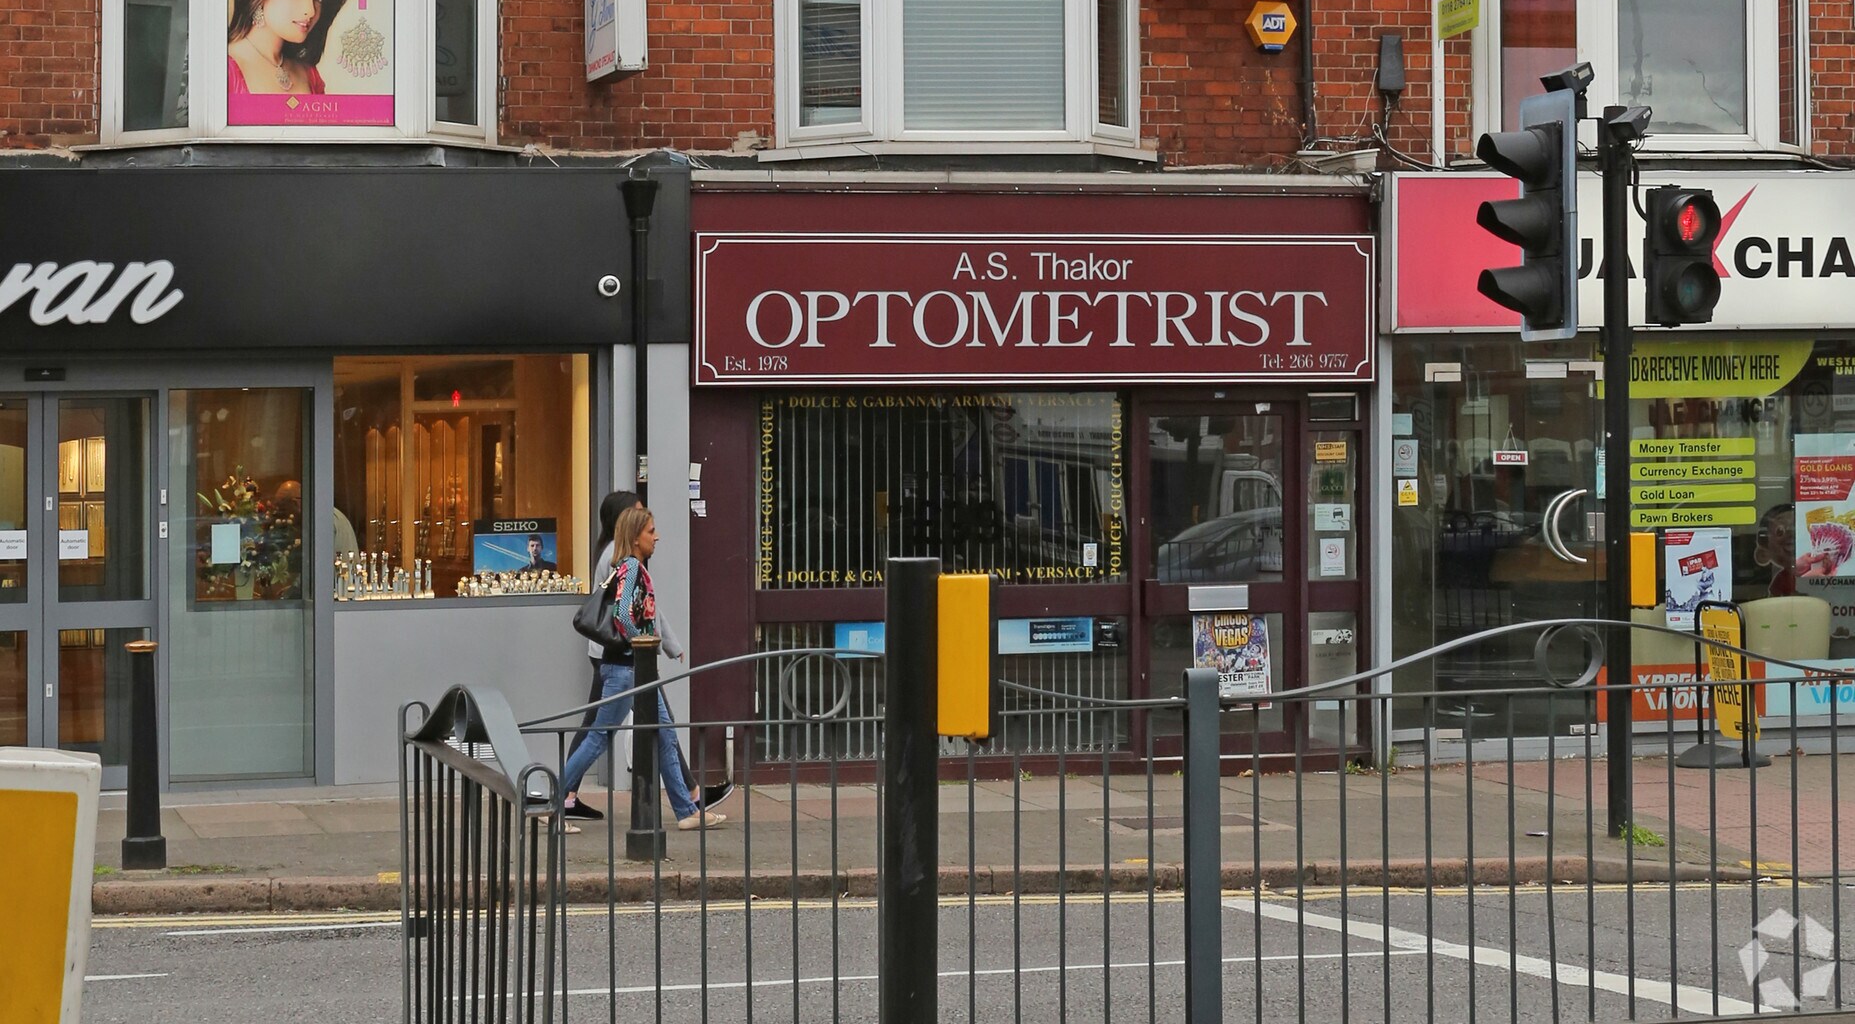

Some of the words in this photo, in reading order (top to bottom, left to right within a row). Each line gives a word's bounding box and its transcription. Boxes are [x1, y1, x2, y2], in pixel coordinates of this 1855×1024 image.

[1263, 17, 1286, 30] ADT
[302, 102, 338, 112] AGNI
[953, 252, 1016, 280] A.S.
[1030, 252, 1133, 280] Thakor
[746, 290, 1328, 348] OPTOMETRIST
[724, 356, 751, 371] Est.
[758, 356, 788, 371] 1978
[1259, 354, 1284, 368] Tel:
[1289, 354, 1314, 368] 266
[1319, 354, 1348, 368] 9757
[1702, 355, 1746, 381] MONEY
[1750, 354, 1780, 380] HERE
[789, 396, 841, 408] DOLCE
[846, 396, 857, 408] &
[863, 396, 937, 408] GABANNA
[952, 395, 1012, 407] ARMANI
[762, 400, 774, 455] VOGUE
[1640, 443, 1674, 454] Money
[1679, 442, 1721, 452] Transfer
[1640, 466, 1688, 478] Currency
[1692, 465, 1744, 476] Exchange
[1800, 464, 1822, 472] GOLD
[1824, 464, 1853, 472] LOANS
[762, 466, 774, 516] GUCCI
[1112, 462, 1122, 511] GUCCI
[1640, 490, 1665, 500] Gold
[1670, 490, 1695, 500] Loan
[1640, 513, 1668, 523] Pawn
[1672, 512, 1714, 522] Brokers
[493, 521, 538, 532] SEIKO
[762, 525, 773, 582] POLICE
[1110, 520, 1122, 577] POLICE
[787, 570, 840, 583] DOLCE
[845, 570, 856, 582] &
[1026, 567, 1094, 580] VERSACE
[1214, 614, 1248, 627] CIRCUS
[1214, 627, 1249, 646] VEGAS
[1715, 678, 1741, 706] HERE
